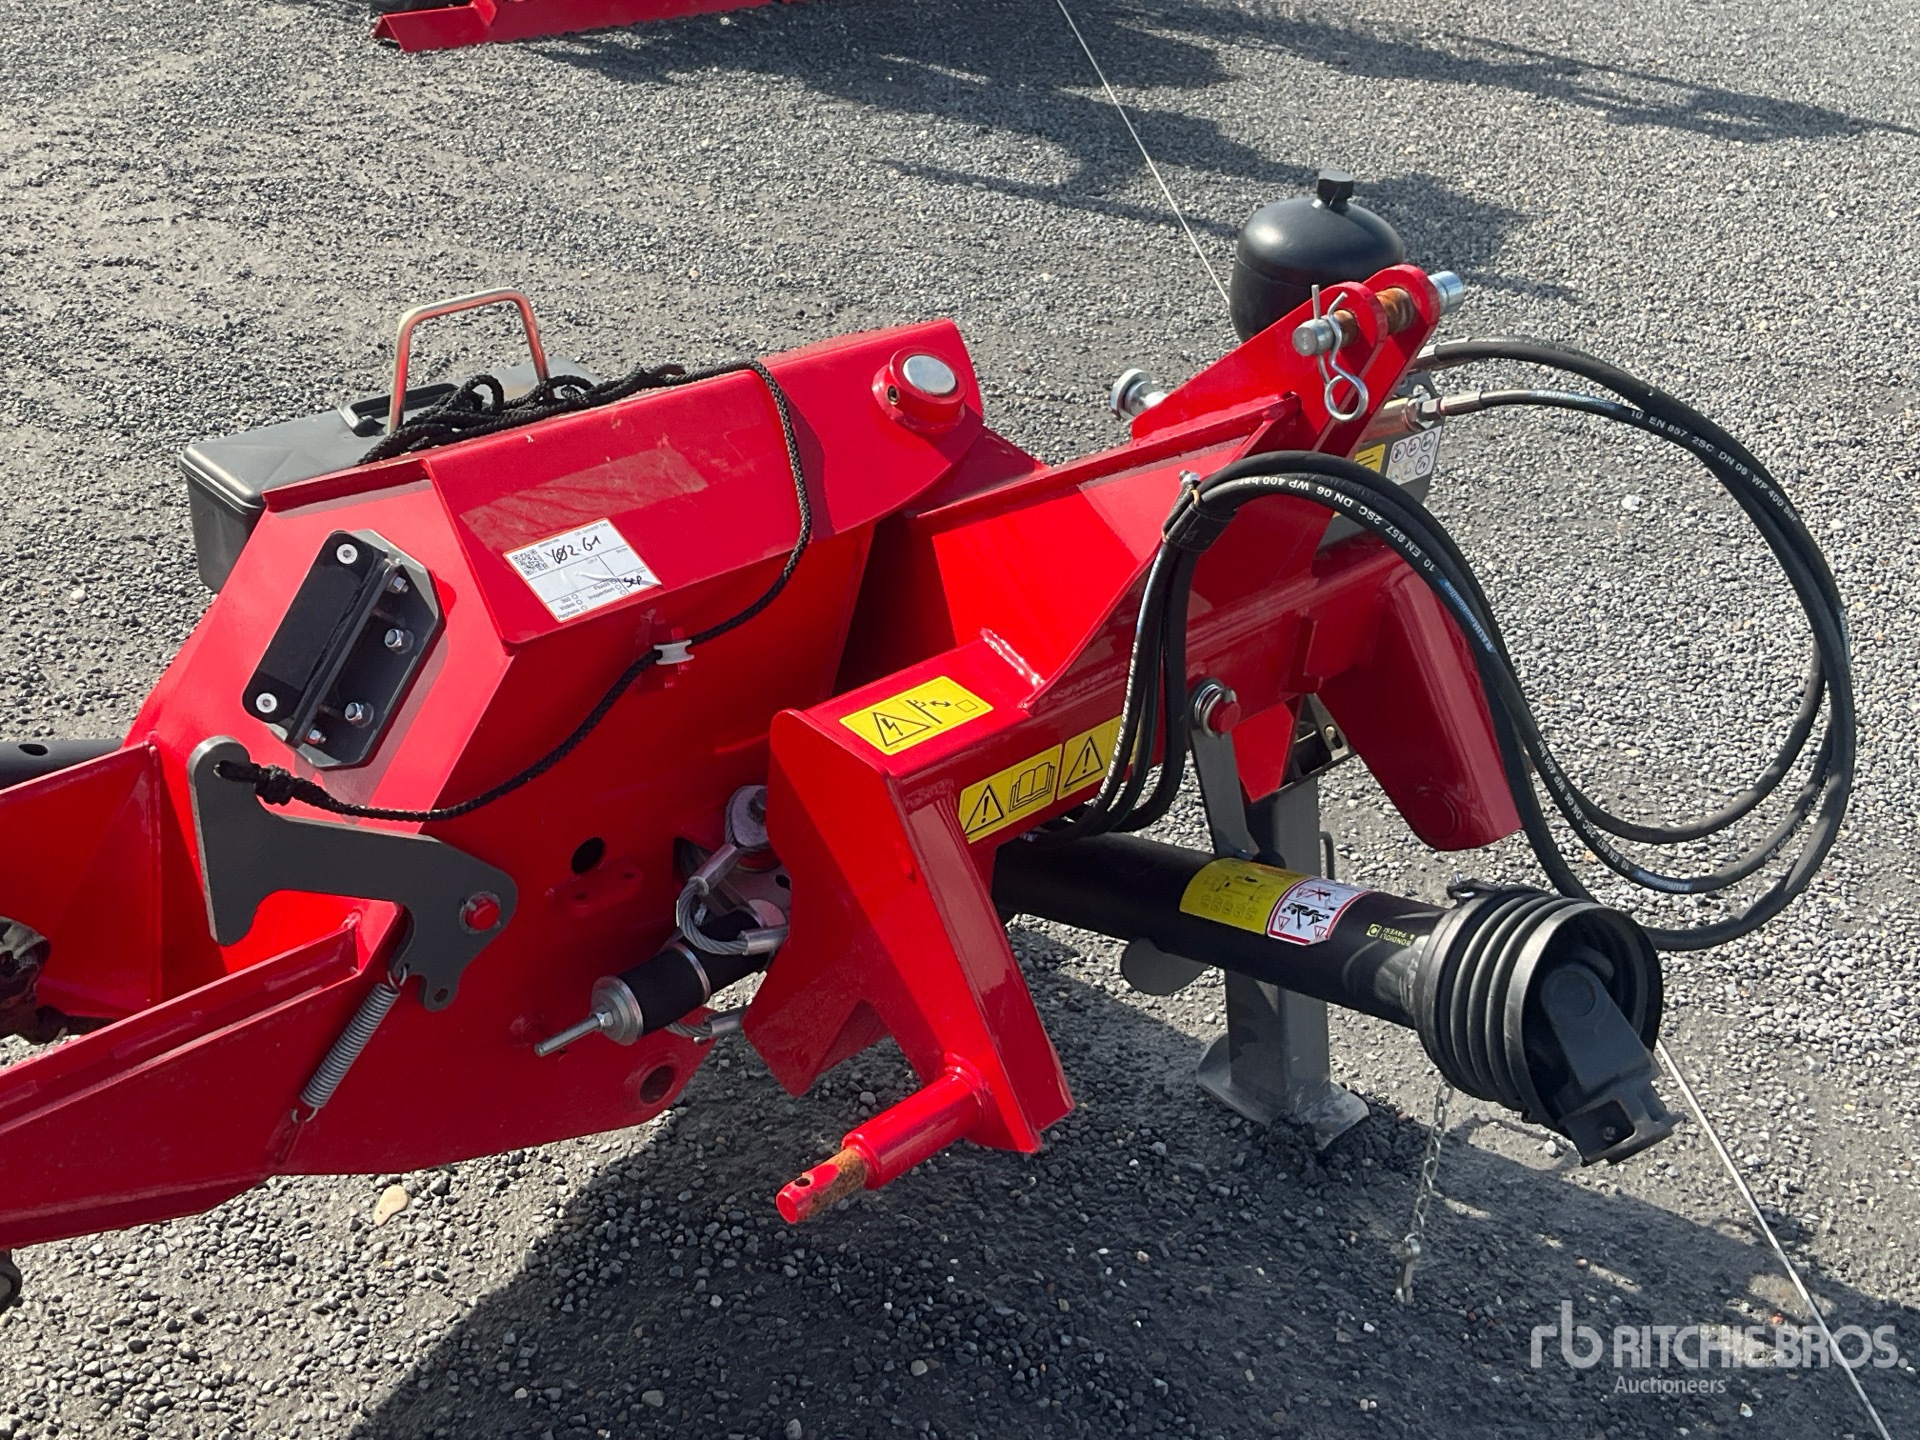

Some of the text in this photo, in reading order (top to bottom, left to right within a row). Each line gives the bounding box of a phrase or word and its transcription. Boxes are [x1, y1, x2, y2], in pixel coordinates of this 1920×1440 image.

[1630, 410, 1643, 420] 10
[1649, 416, 1665, 429] EN
[1667, 424, 1688, 438] 857
[1692, 437, 1715, 452] 2SC
[1718, 452, 1734, 466] DN
[1735, 463, 1748, 475] 06
[1751, 474, 1768, 490] WP
[1768, 490, 1784, 507] 400
[1783, 504, 1798, 522] bar
[1262, 476, 1286, 485] 400
[1288, 482, 1309, 491] WP
[1316, 486, 1332, 497] 06
[1334, 493, 1353, 508] DN
[1358, 506, 1382, 525] 2SC
[1385, 525, 1406, 543] 857
[1405, 541, 1421, 558] EN
[1424, 559, 1435, 572] 10
[1537, 740, 1548, 757] bar
[1545, 757, 1556, 774] 400
[1554, 776, 1566, 792] WP
[1564, 793, 1574, 806] 06
[1571, 806, 1583, 820] DN
[1582, 820, 1597, 838] 2SC
[1608, 851, 1620, 863] EN
[1621, 860, 1629, 871] 10
[1383, 927, 1407, 938] PAVESI
[1380, 933, 1412, 947] BONDIOLI
